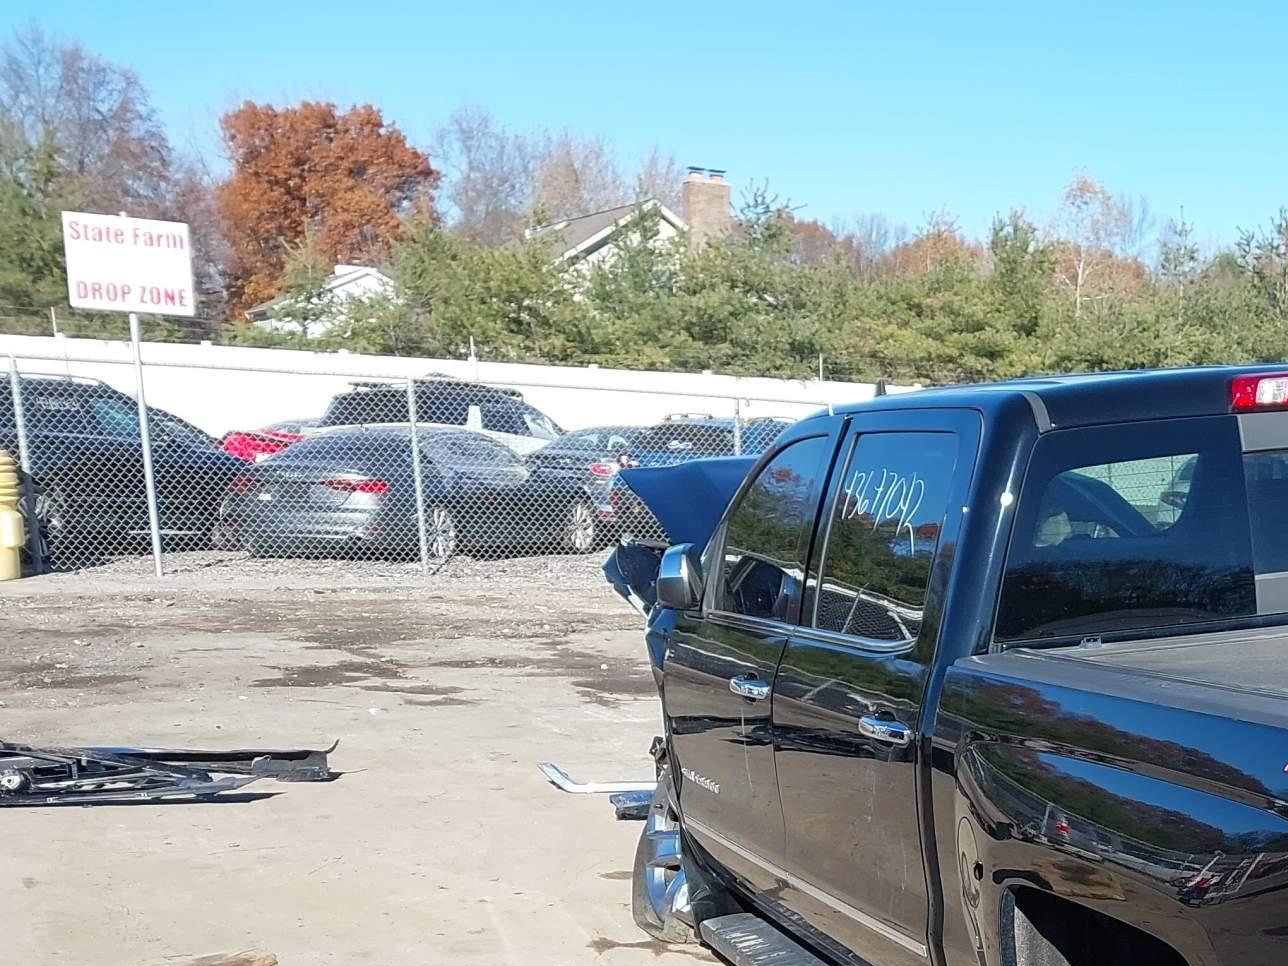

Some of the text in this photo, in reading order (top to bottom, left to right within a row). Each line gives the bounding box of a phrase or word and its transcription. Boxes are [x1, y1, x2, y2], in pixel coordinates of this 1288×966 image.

[68, 220, 185, 249] State Farm
[76, 280, 188, 307] DROP ZONE
